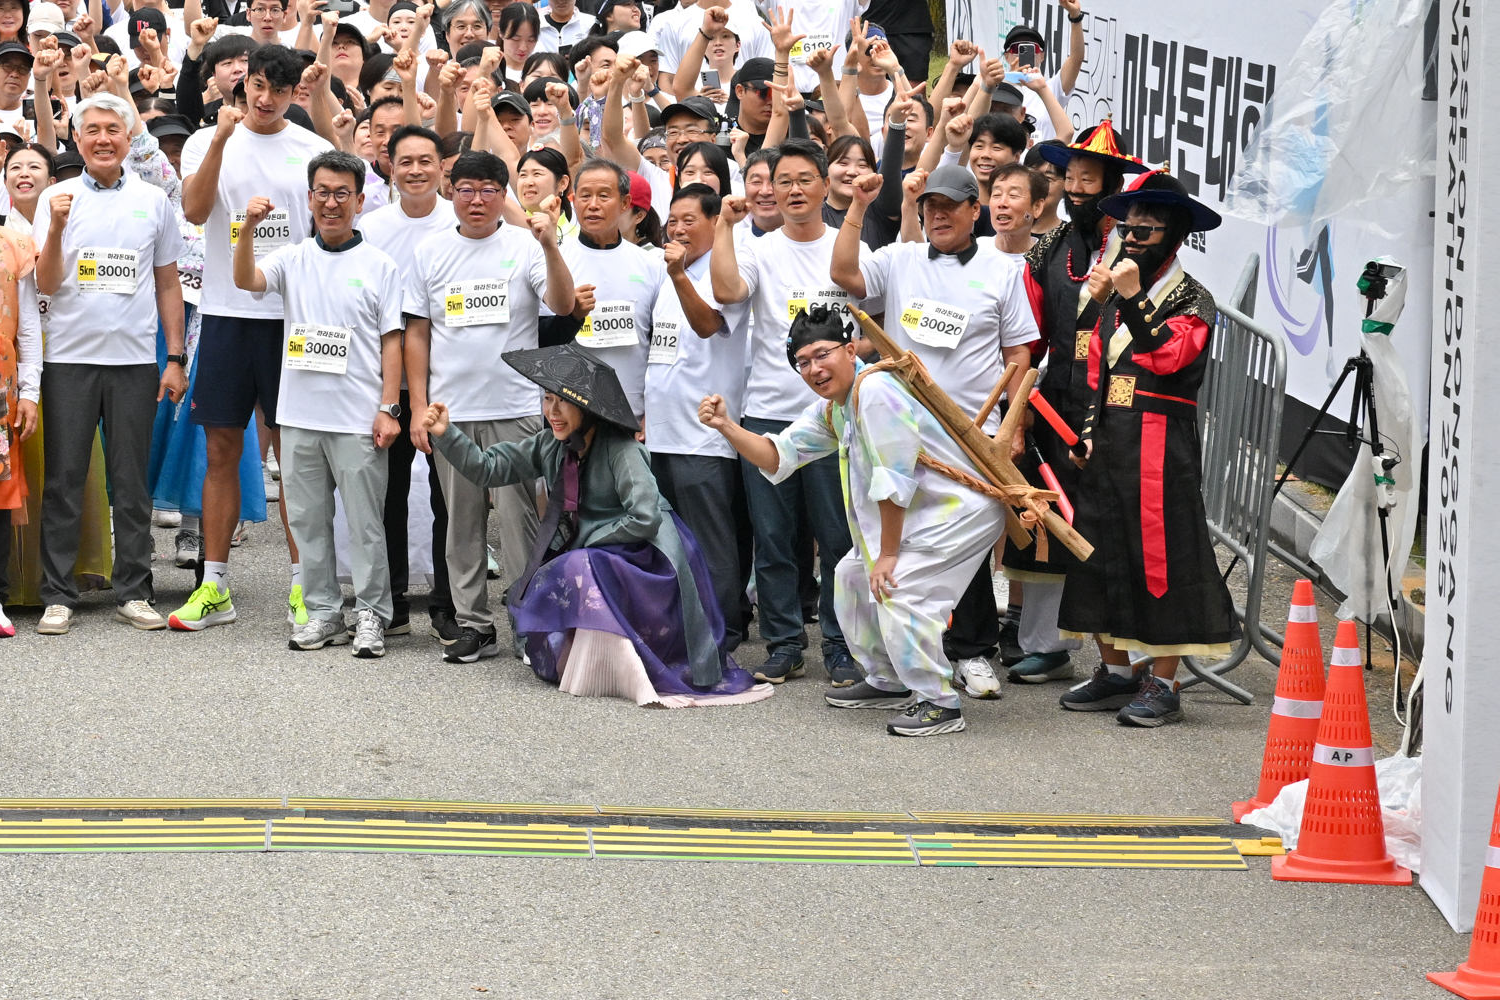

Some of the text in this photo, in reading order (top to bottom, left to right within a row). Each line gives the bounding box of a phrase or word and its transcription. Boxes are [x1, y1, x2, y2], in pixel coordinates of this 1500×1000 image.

[83, 251, 136, 262] 정선 마라톤대회
[79, 265, 137, 279] 5km 30001
[450, 283, 504, 294] 정선 마라톤대회
[818, 290, 848, 298] 마라톤대회
[447, 295, 507, 311] 5km 30007
[601, 305, 631, 313] 마라톤대회
[593, 318, 634, 332] 30008
[902, 313, 962, 337] 5km 30020
[316, 330, 346, 339] 마라톤대회
[289, 341, 347, 358] 5km 30003
[1437, 421, 1451, 600] 2025
[1445, 294, 1464, 716] DONGGANG
[1331, 750, 1353, 762] AP
